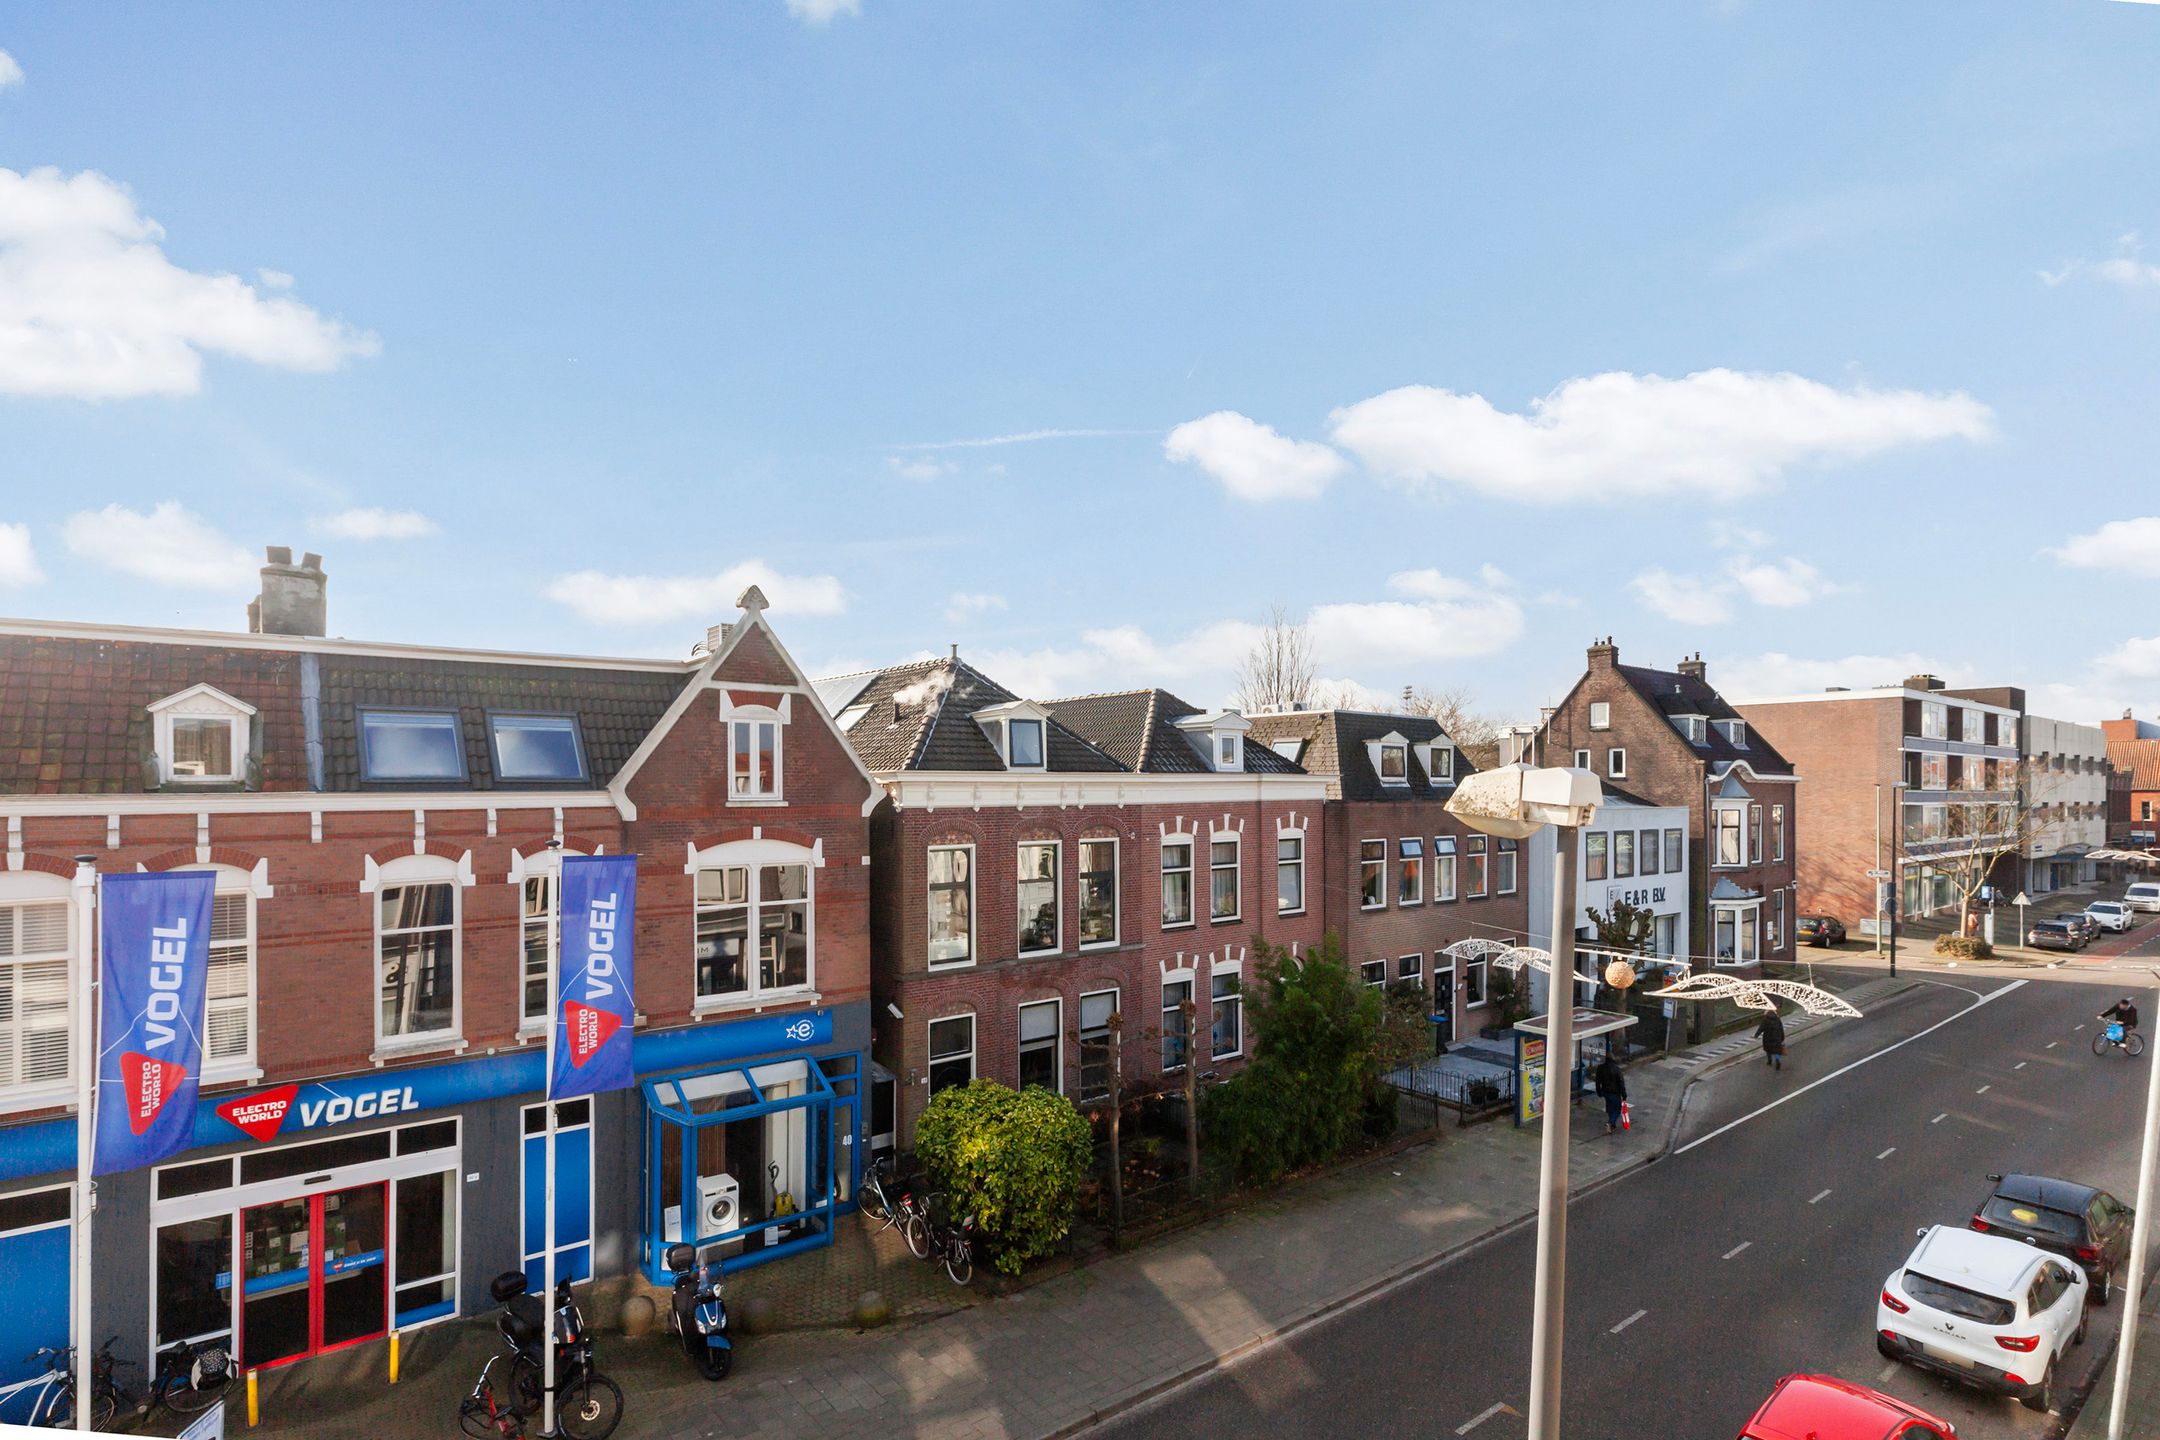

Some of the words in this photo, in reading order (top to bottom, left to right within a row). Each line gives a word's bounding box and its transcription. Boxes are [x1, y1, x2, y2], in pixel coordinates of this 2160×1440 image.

[1624, 889, 1648, 906] E&R
[585, 892, 617, 1001] VOGEL
[145, 917, 187, 1051] VOGEL
[578, 1008, 589, 1055] ELECTRO
[588, 1011, 598, 1049] WORLD
[140, 1061, 152, 1118] ELECTRO
[151, 1062, 162, 1110] WORLD
[300, 1086, 419, 1127] VOGEL
[232, 1100, 287, 1117] ELECTRO
[237, 1110, 283, 1125] WORLD
